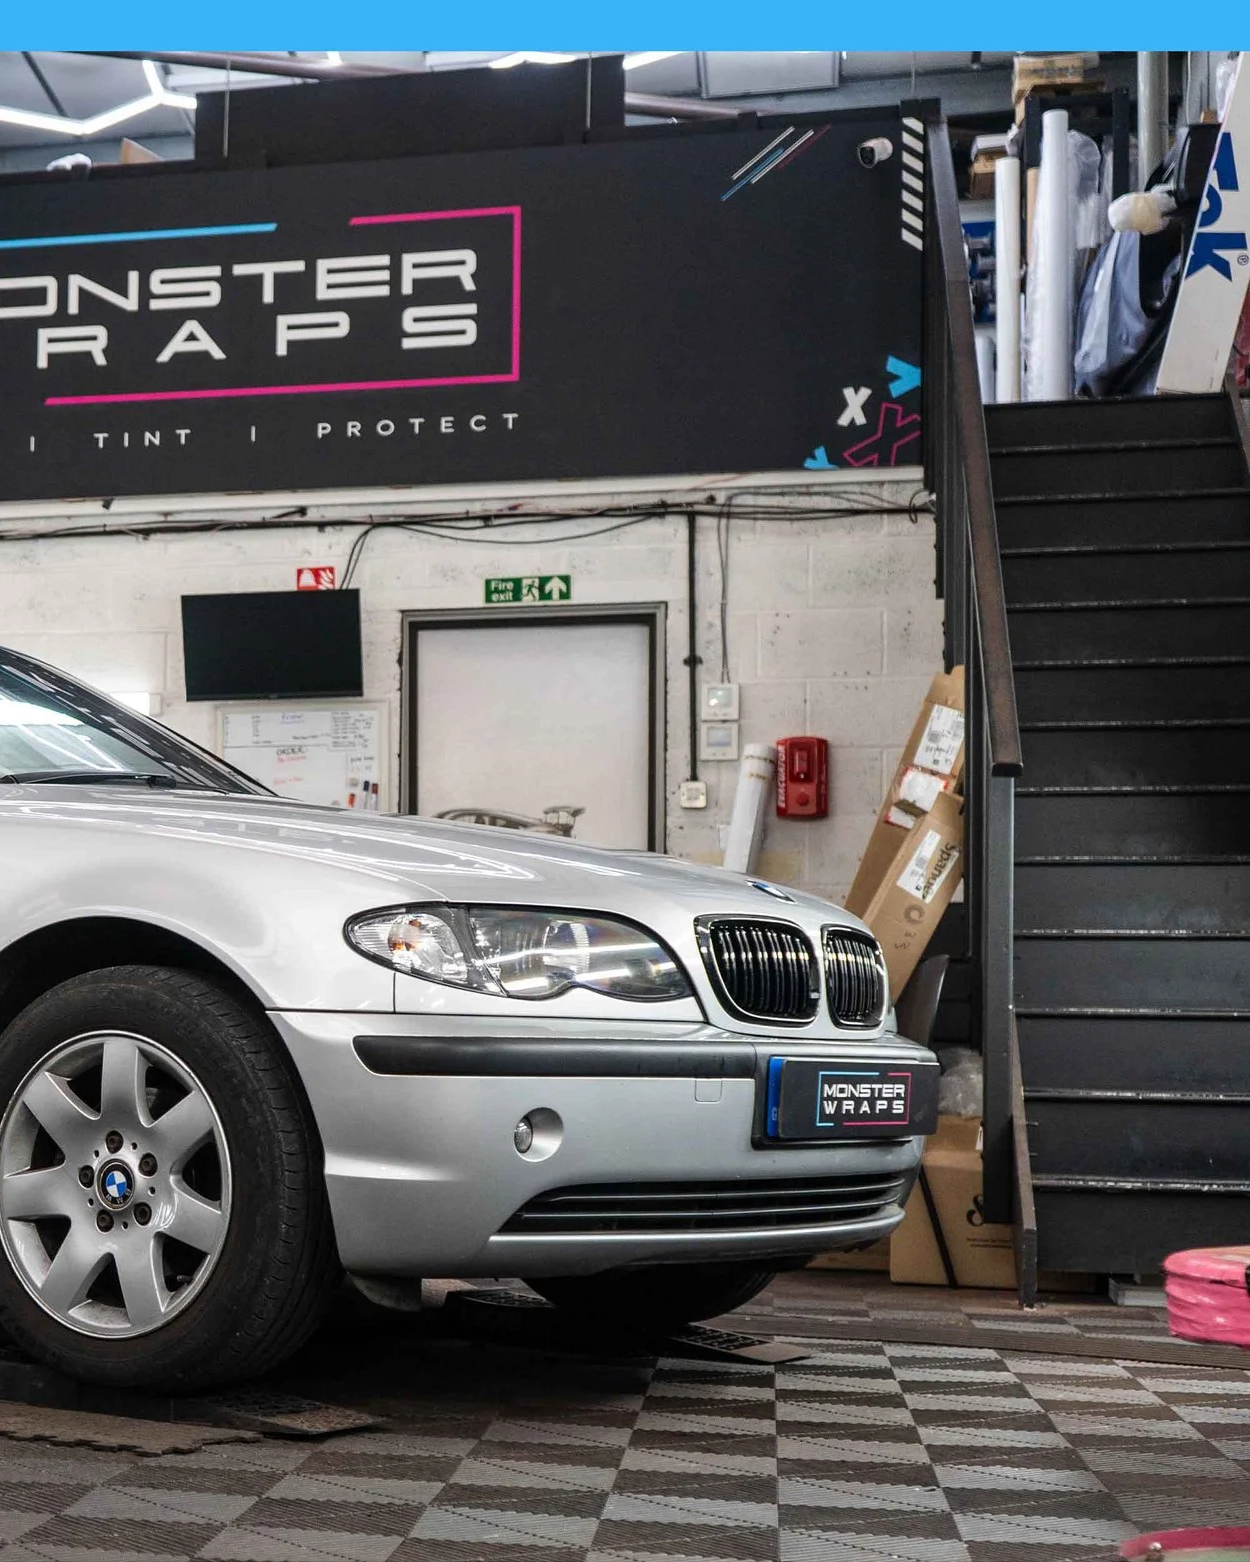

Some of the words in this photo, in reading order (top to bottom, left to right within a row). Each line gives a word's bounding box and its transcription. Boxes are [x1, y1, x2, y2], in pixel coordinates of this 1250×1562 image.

[93, 427, 192, 450] TINT
[316, 411, 520, 440] PROTECT
[491, 580, 515, 591] Fire
[491, 591, 513, 602] exit
[823, 1083, 906, 1098] MONSTER
[822, 1099, 906, 1115] WRAPS
